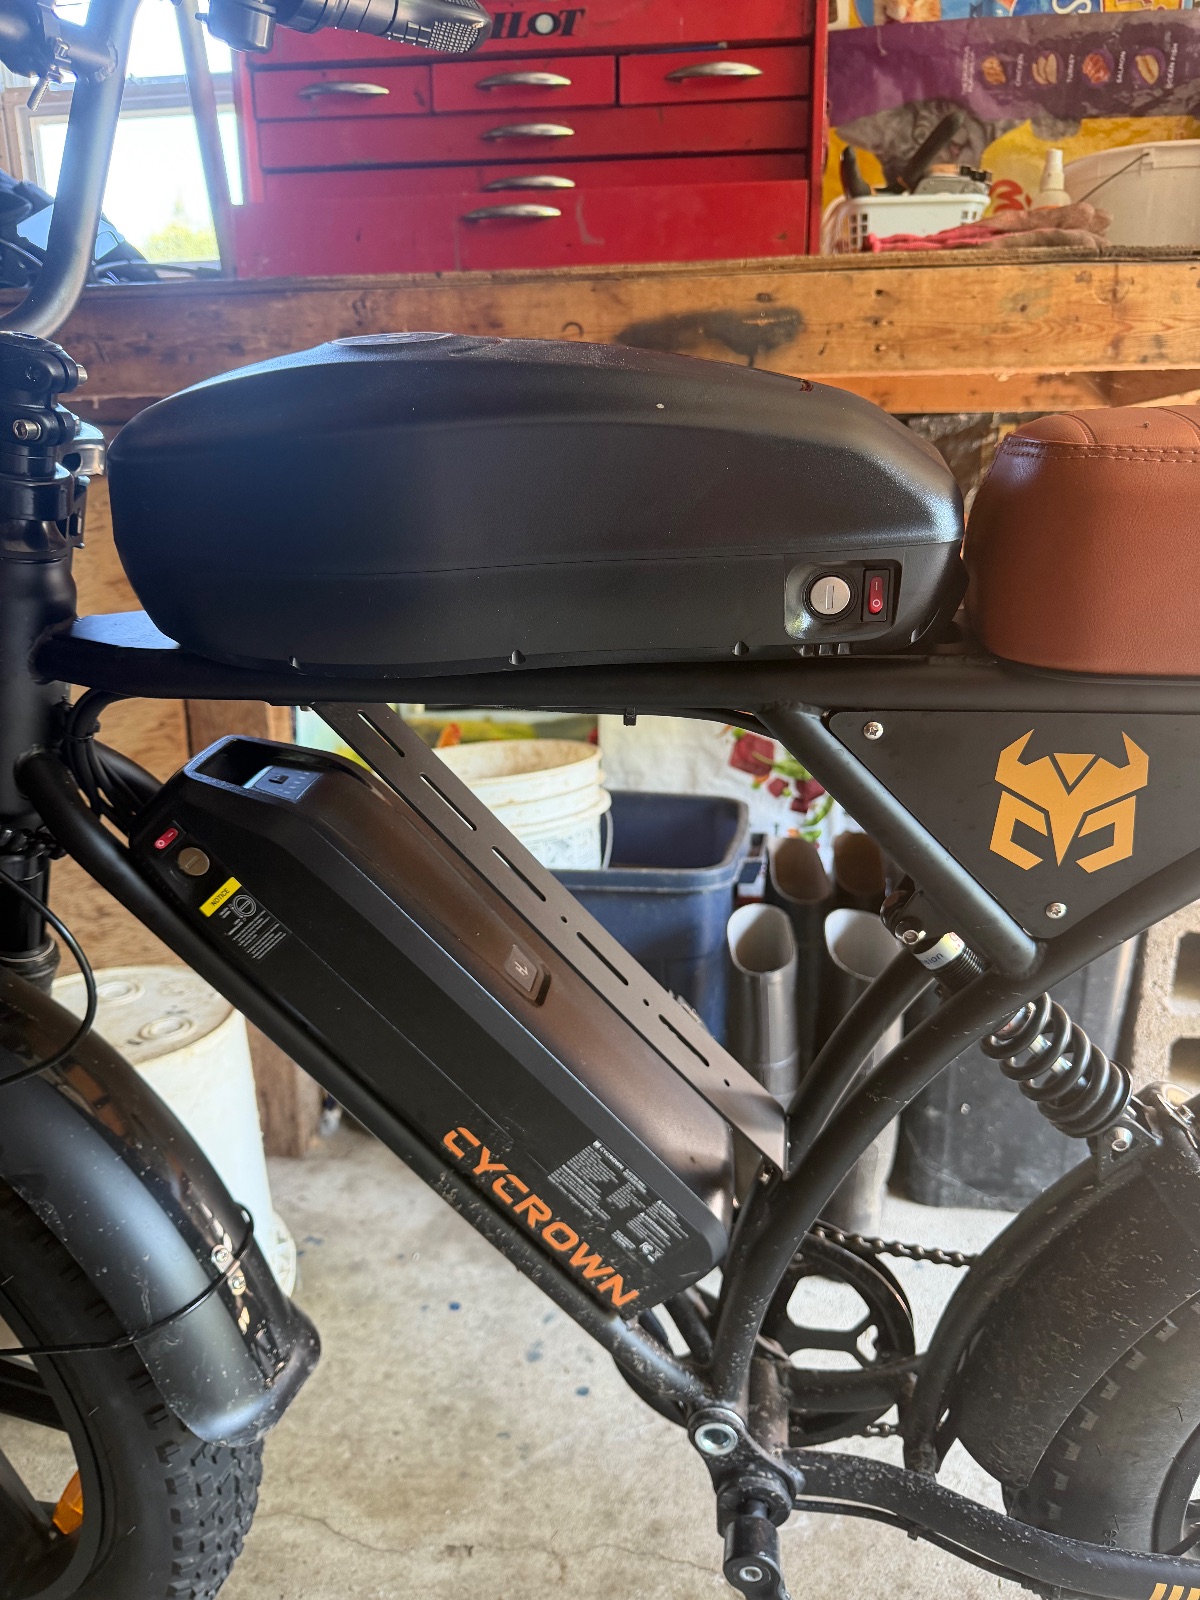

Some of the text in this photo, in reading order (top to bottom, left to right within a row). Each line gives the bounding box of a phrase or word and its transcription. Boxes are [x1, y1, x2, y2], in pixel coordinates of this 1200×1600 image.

[489, 9, 586, 39] ILOT
[1066, 53, 1075, 83] TURKEY
[1116, 51, 1126, 83] SALMON
[1165, 61, 1175, 89] OCEAN
[211, 888, 230, 907] NOTICE
[443, 1127, 639, 1307] CYCROWN
